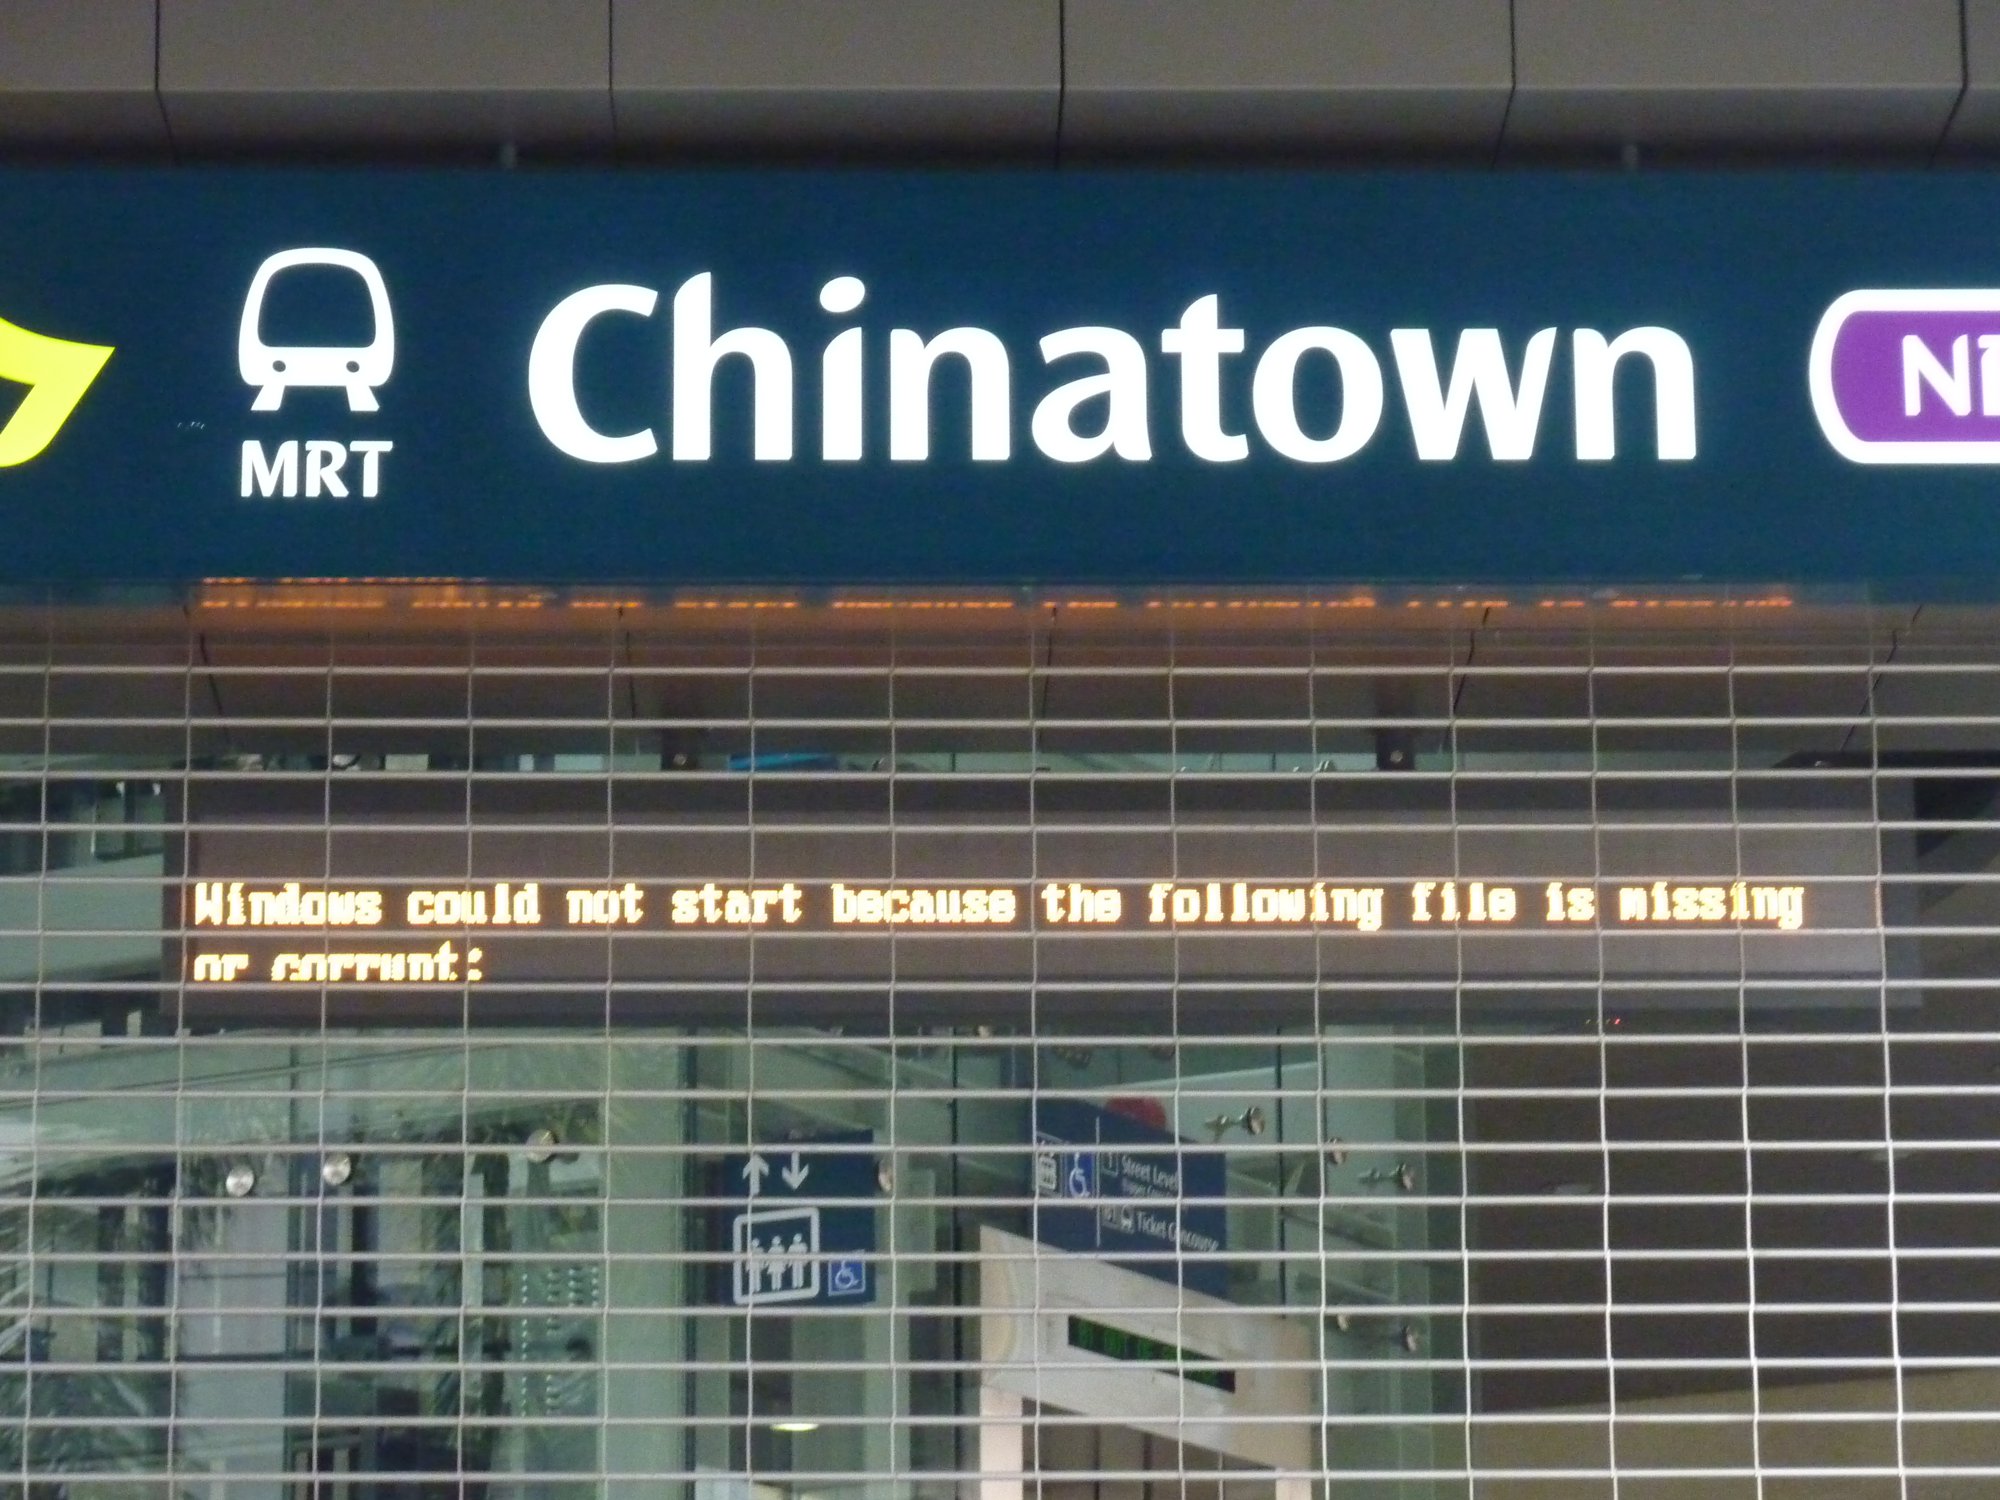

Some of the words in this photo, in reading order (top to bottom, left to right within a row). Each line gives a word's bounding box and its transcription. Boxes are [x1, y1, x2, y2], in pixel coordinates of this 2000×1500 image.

[528, 272, 1697, 464] Chinatown
[241, 440, 394, 498] MRT
[194, 882, 383, 926] Windows
[406, 882, 541, 925] could
[565, 882, 645, 924] not
[671, 882, 803, 924] start
[830, 883, 1016, 924] because
[1041, 882, 1122, 924] the
[1148, 882, 1385, 933] following
[1411, 882, 1517, 922] file
[1546, 882, 1596, 922] is
[1619, 881, 1805, 931] missing
[193, 953, 249, 982] or
[1136, 1210, 1167, 1239] Ticket
[1168, 1221, 1220, 1253] Cncourse
